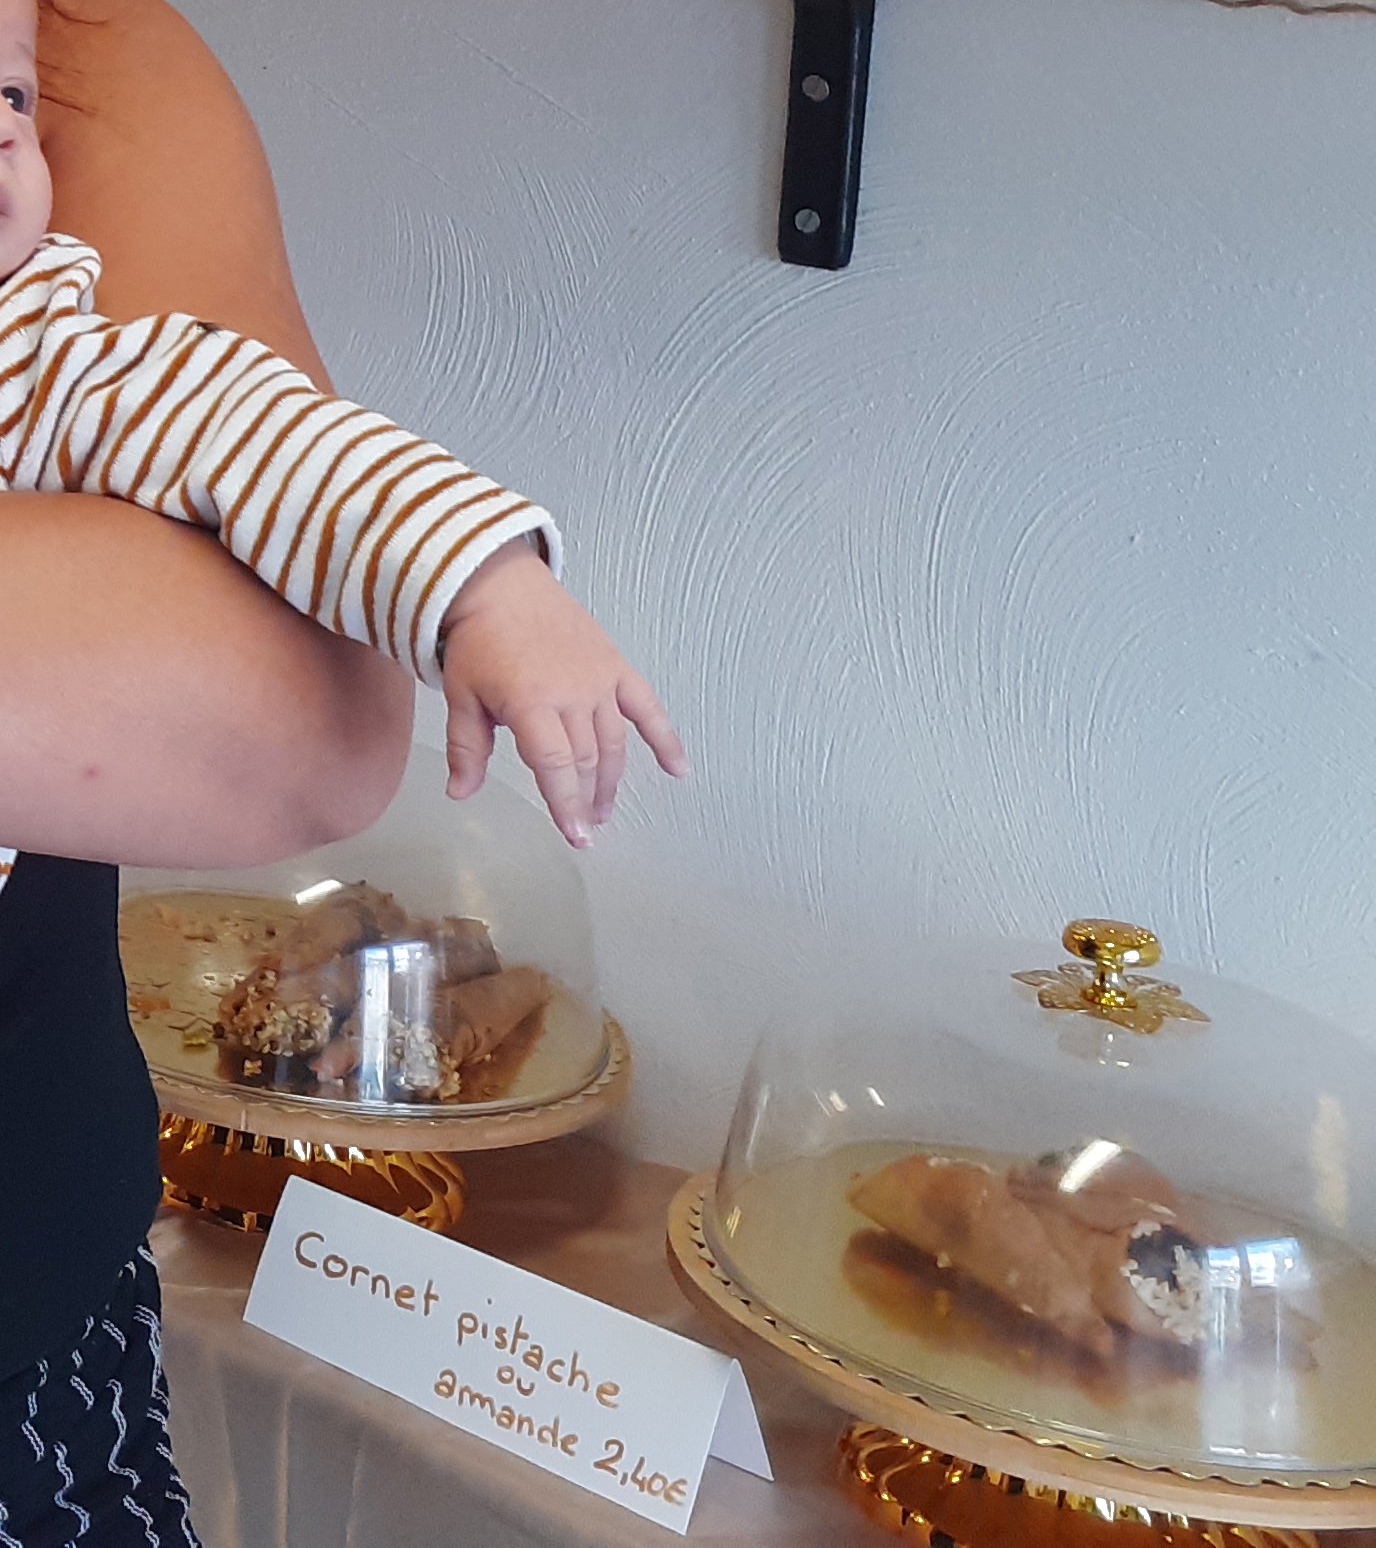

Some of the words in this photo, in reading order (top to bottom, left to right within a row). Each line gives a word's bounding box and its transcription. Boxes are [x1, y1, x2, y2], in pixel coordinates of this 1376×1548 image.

[295, 1231, 440, 1316] Cornet
[458, 1297, 620, 1409] pistache
[496, 1364, 536, 1397] ou
[593, 1438, 688, 1507] 2,40€
